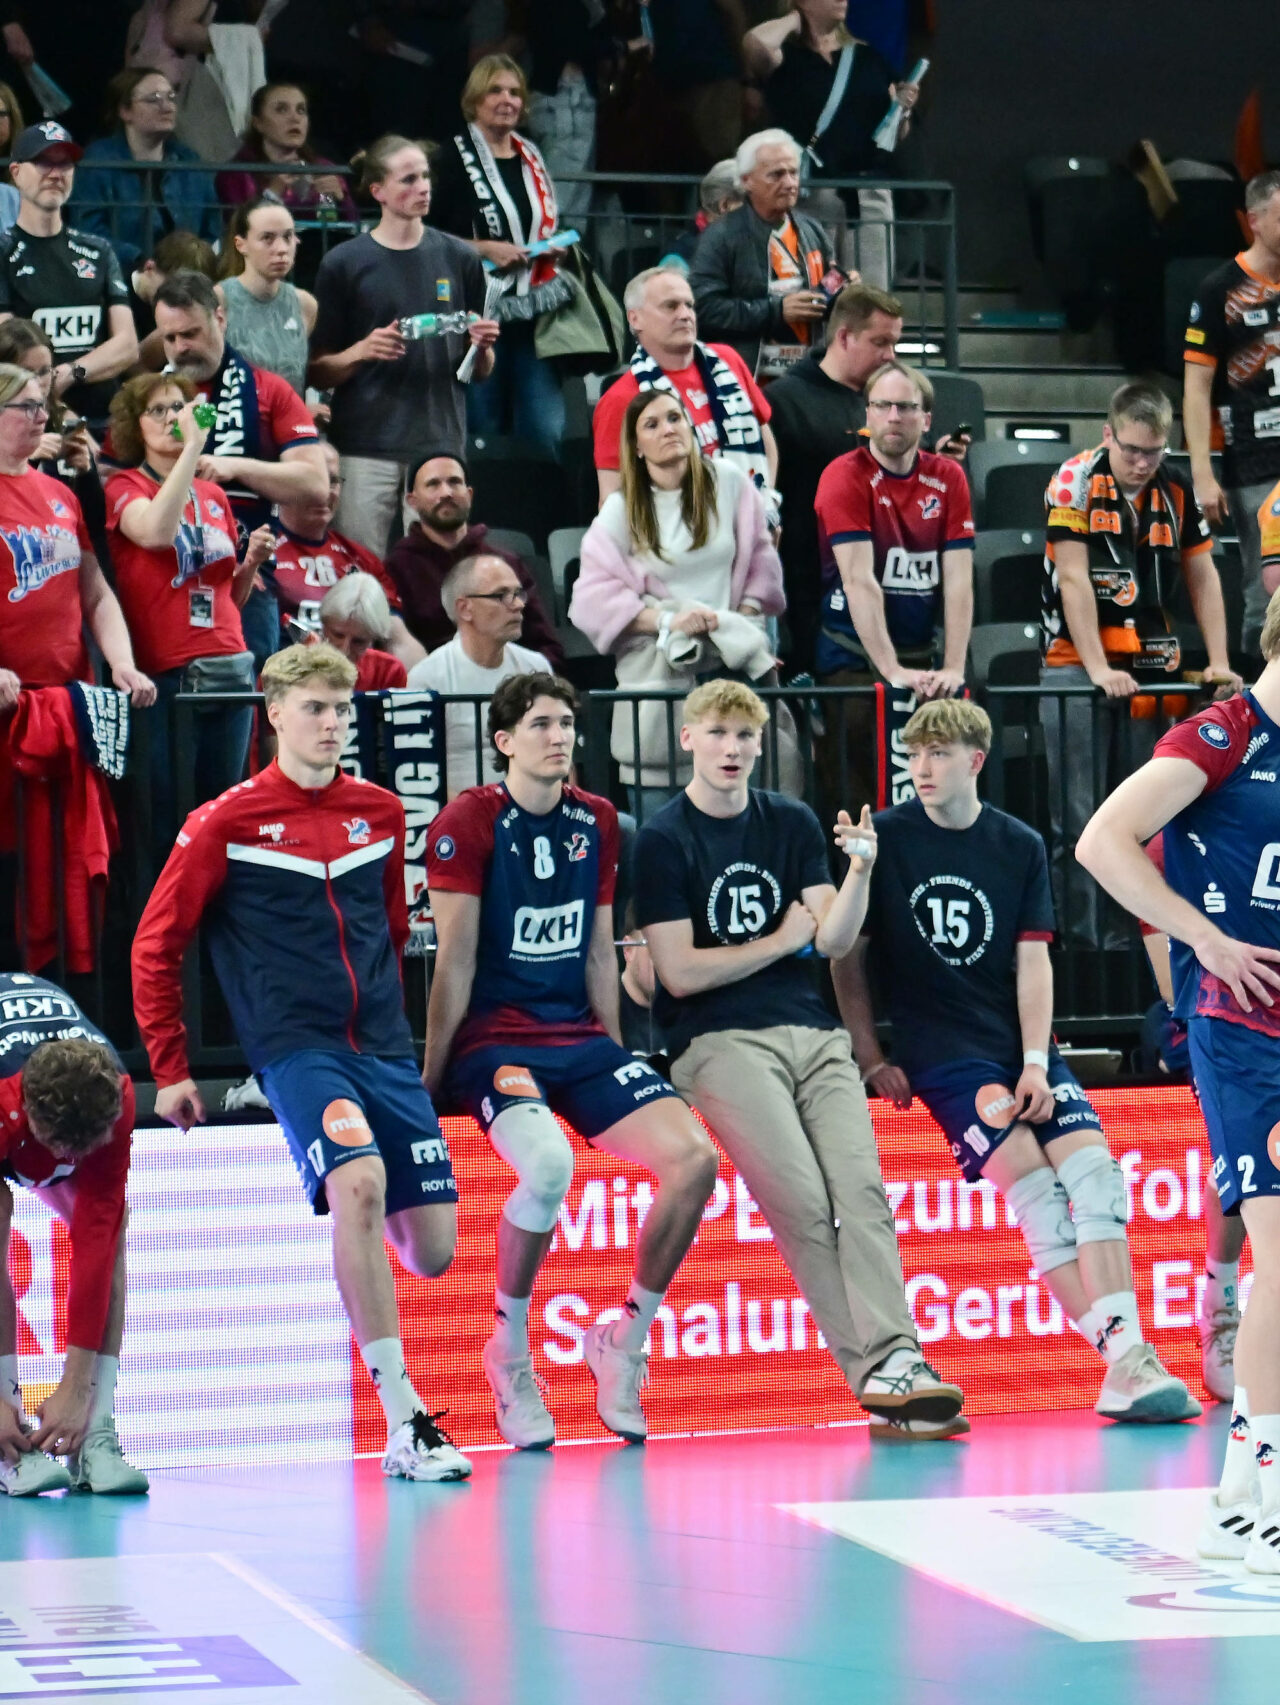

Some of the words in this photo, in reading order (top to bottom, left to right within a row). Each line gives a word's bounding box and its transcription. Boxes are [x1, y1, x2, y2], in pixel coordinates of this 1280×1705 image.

[1250, 770, 1276, 782] JAKO
[259, 823, 285, 835] JAKO
[533, 836, 555, 880] 8
[727, 884, 767, 934] 15
[926, 897, 970, 949] 15
[519, 911, 579, 945] LKH
[1, 996, 71, 1020] LKH
[633, 1083, 662, 1102] ROY
[1057, 1112, 1084, 1128] ROY
[963, 1124, 990, 1157] 10
[306, 1138, 326, 1178] 17
[1237, 1155, 1258, 1194] 2
[420, 1179, 445, 1192] ROY
[550, 1175, 654, 1252] Mit
